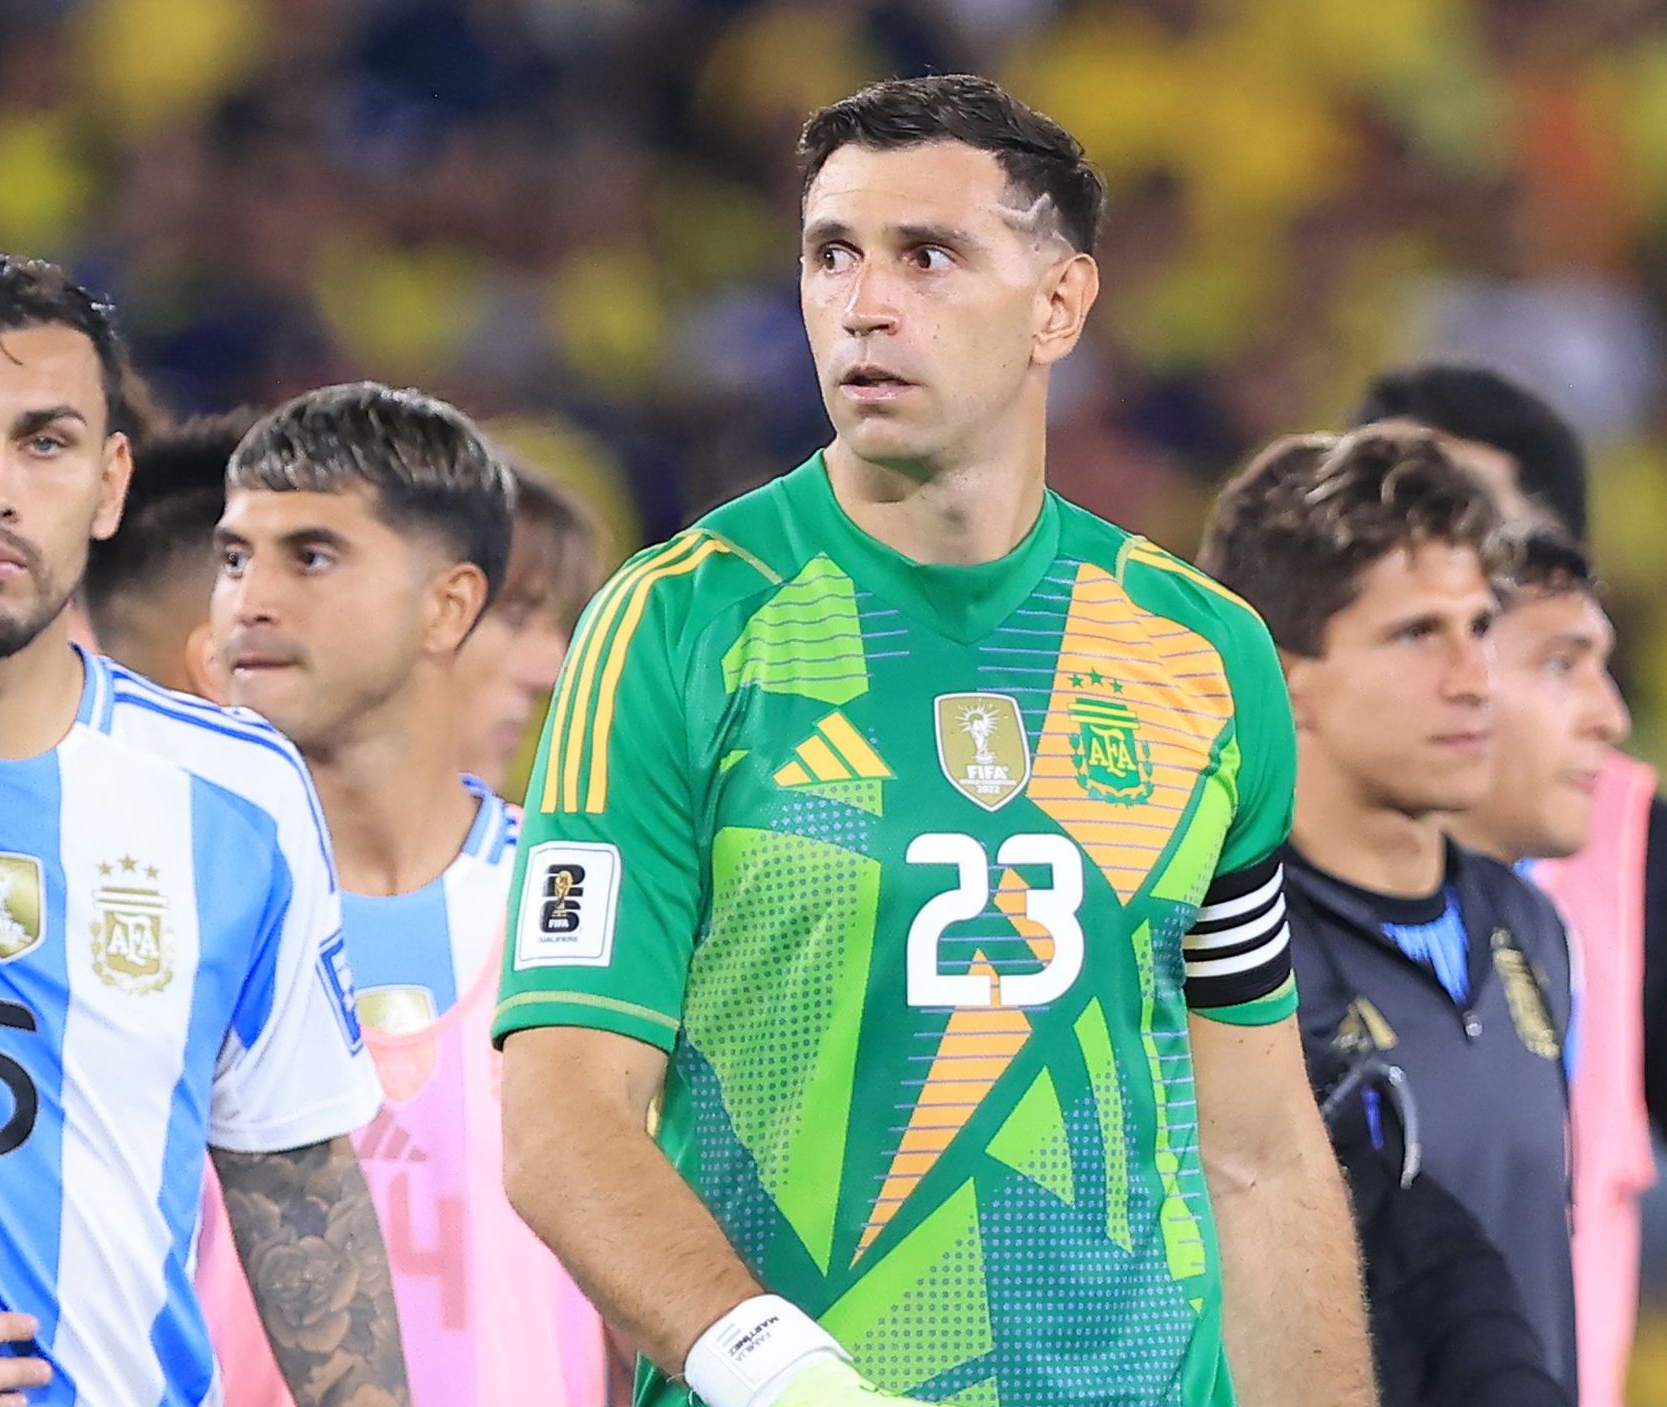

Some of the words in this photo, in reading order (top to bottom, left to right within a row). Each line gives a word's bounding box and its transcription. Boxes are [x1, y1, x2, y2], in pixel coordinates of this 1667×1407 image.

[967, 764, 1007, 780] FIFA
[1088, 725, 1137, 778] AFA
[107, 912, 160, 967] AFA
[548, 918, 569, 929] FIFA
[905, 832, 1085, 1008] 23
[388, 1171, 468, 1332] 4
